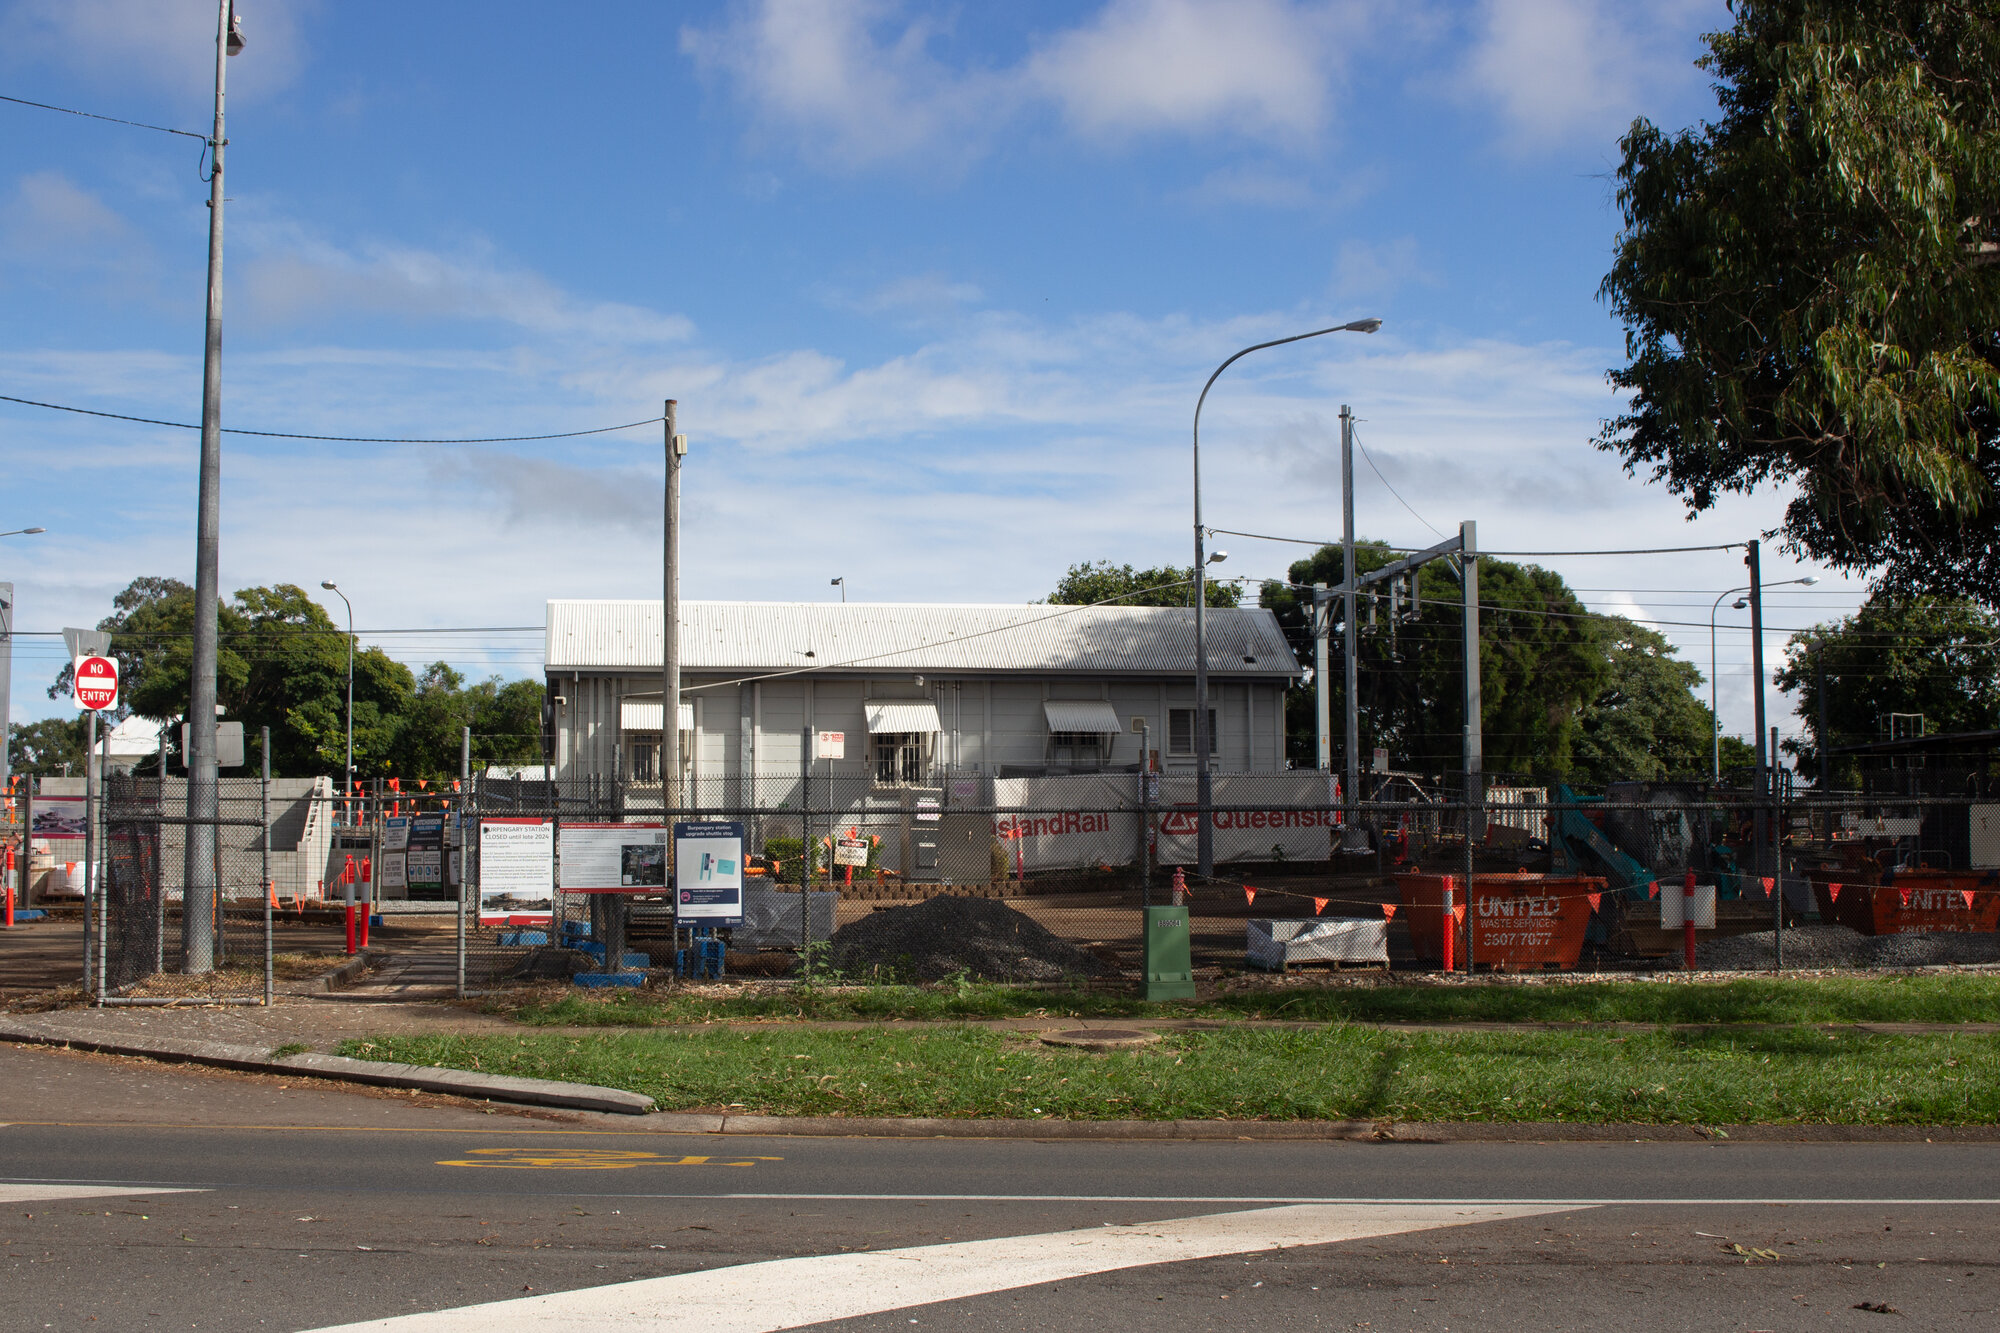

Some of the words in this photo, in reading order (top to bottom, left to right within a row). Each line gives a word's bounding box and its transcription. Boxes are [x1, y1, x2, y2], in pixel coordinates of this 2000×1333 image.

[90, 663, 104, 674] NO
[81, 690, 112, 701] ENTRY
[1479, 896, 1560, 917] UNITED
[1480, 918, 1512, 929] WASTE
[1513, 918, 1558, 928] SERVICES
[1520, 932, 1553, 946] 7077
